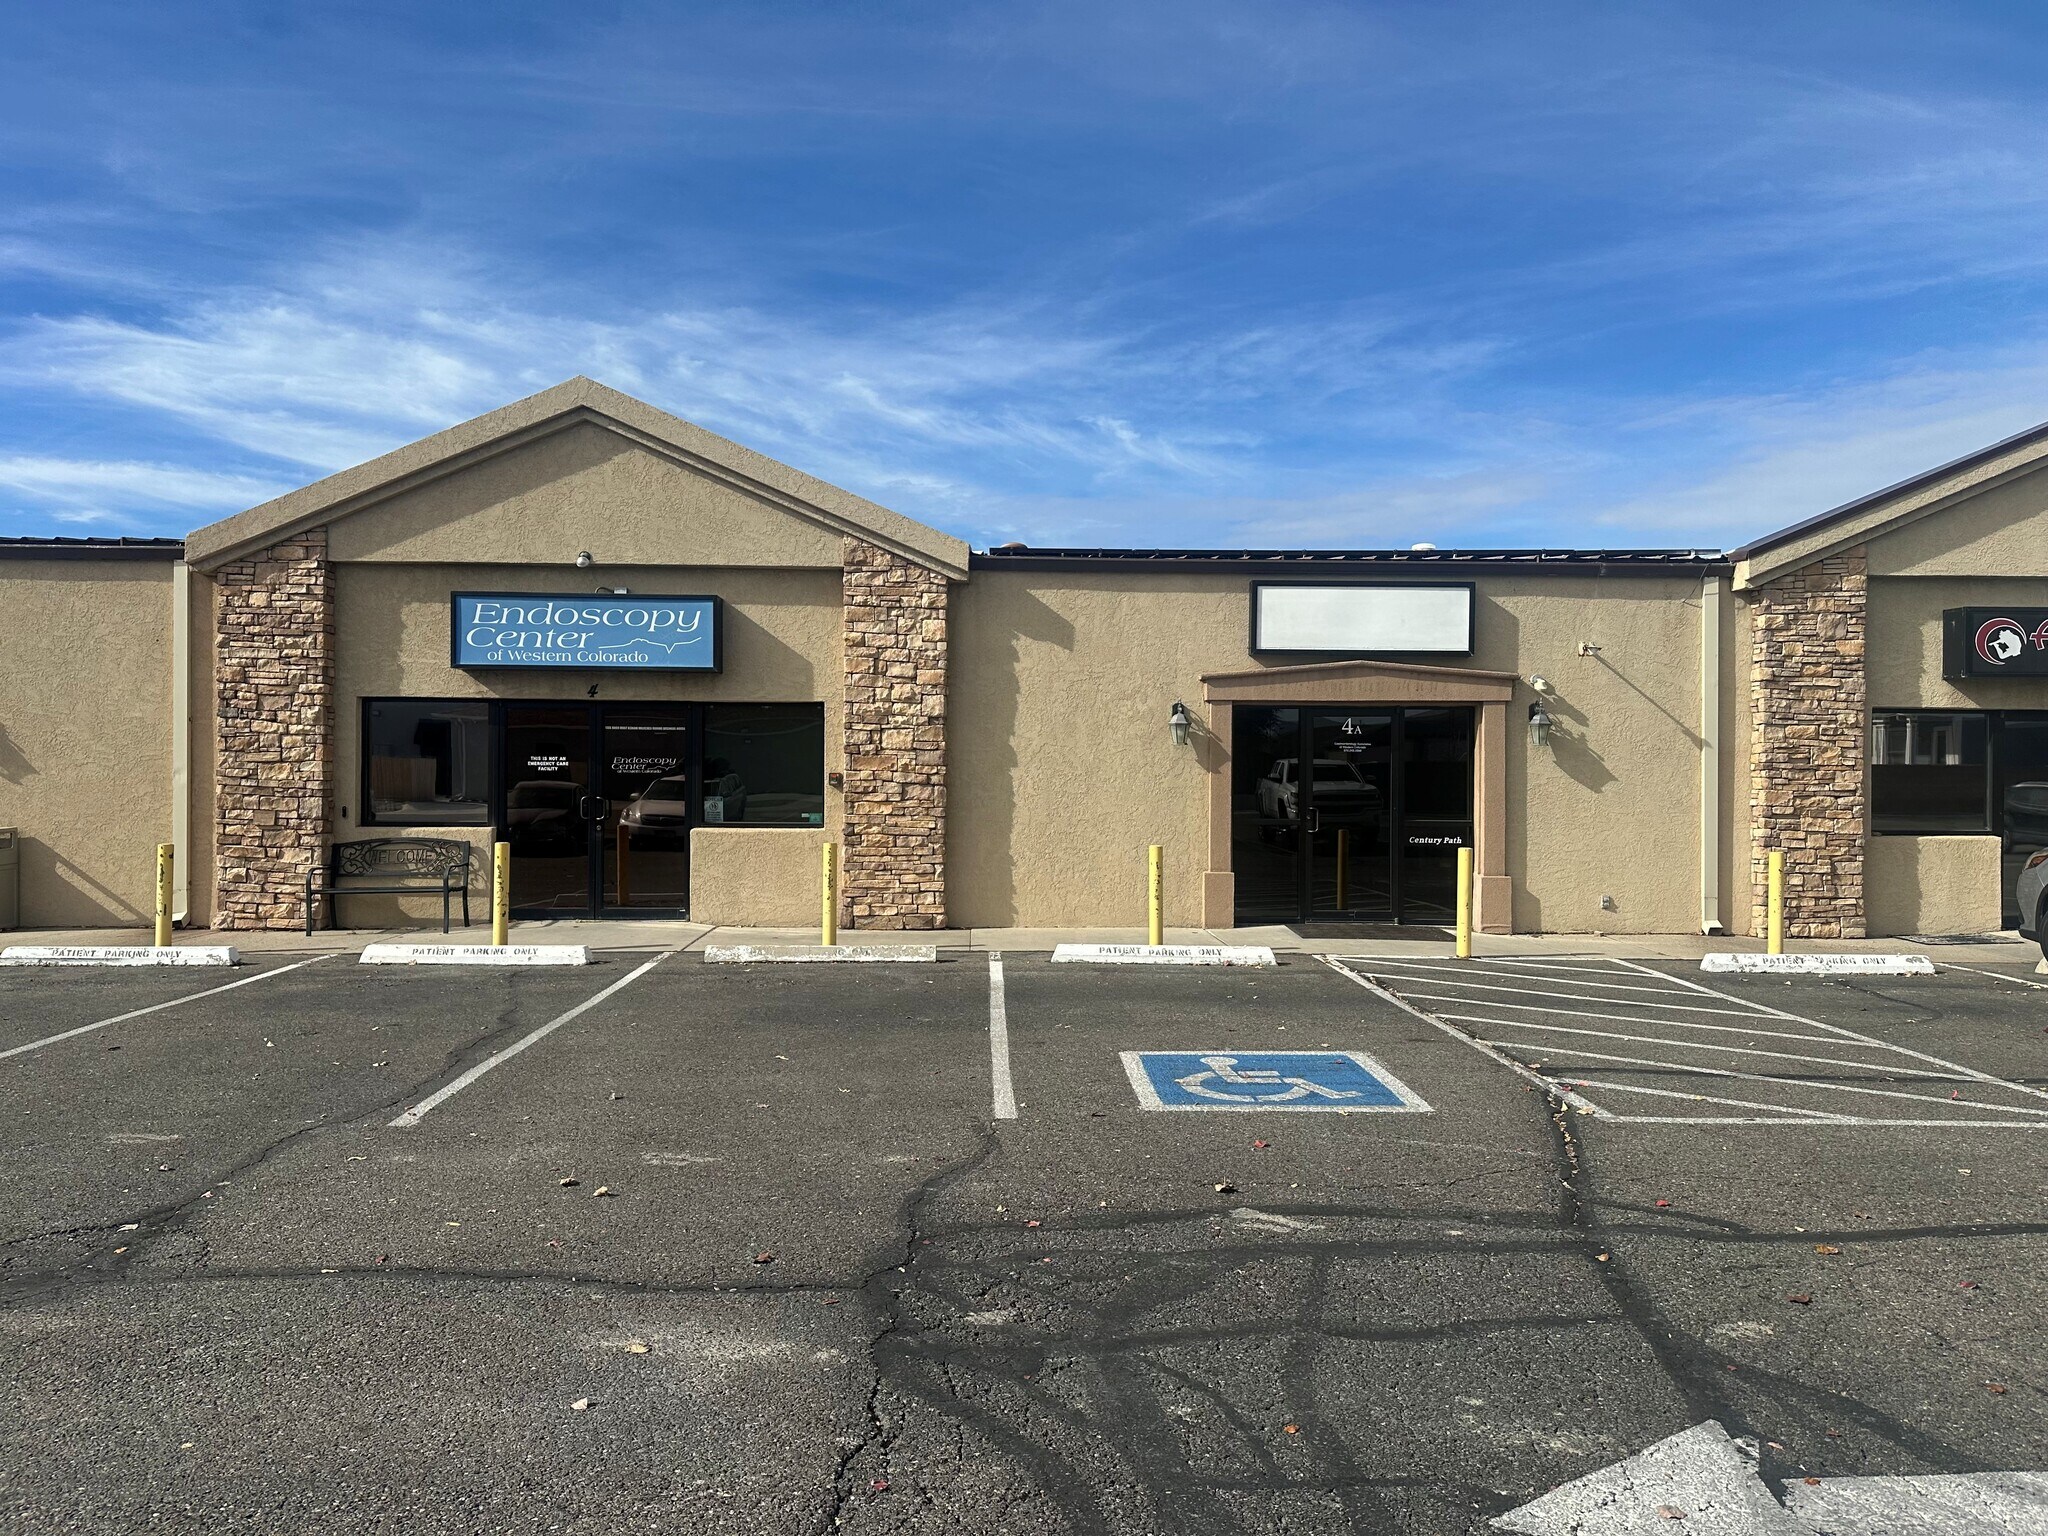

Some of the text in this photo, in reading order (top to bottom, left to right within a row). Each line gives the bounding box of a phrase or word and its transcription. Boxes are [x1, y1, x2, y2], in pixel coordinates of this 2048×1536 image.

[472, 602, 701, 633] Endoscopy
[466, 627, 594, 649] Center
[487, 649, 649, 663] of Western Colorado
[587, 683, 599, 698] 4
[613, 756, 677, 765] Endoscopy
[1409, 836, 1442, 845] Century
[51, 949, 182, 958] PATIENT PARKING ONLY
[1099, 947, 1222, 956] PATIENT PARKING ONLY
[1762, 956, 1805, 965] PATIENT
